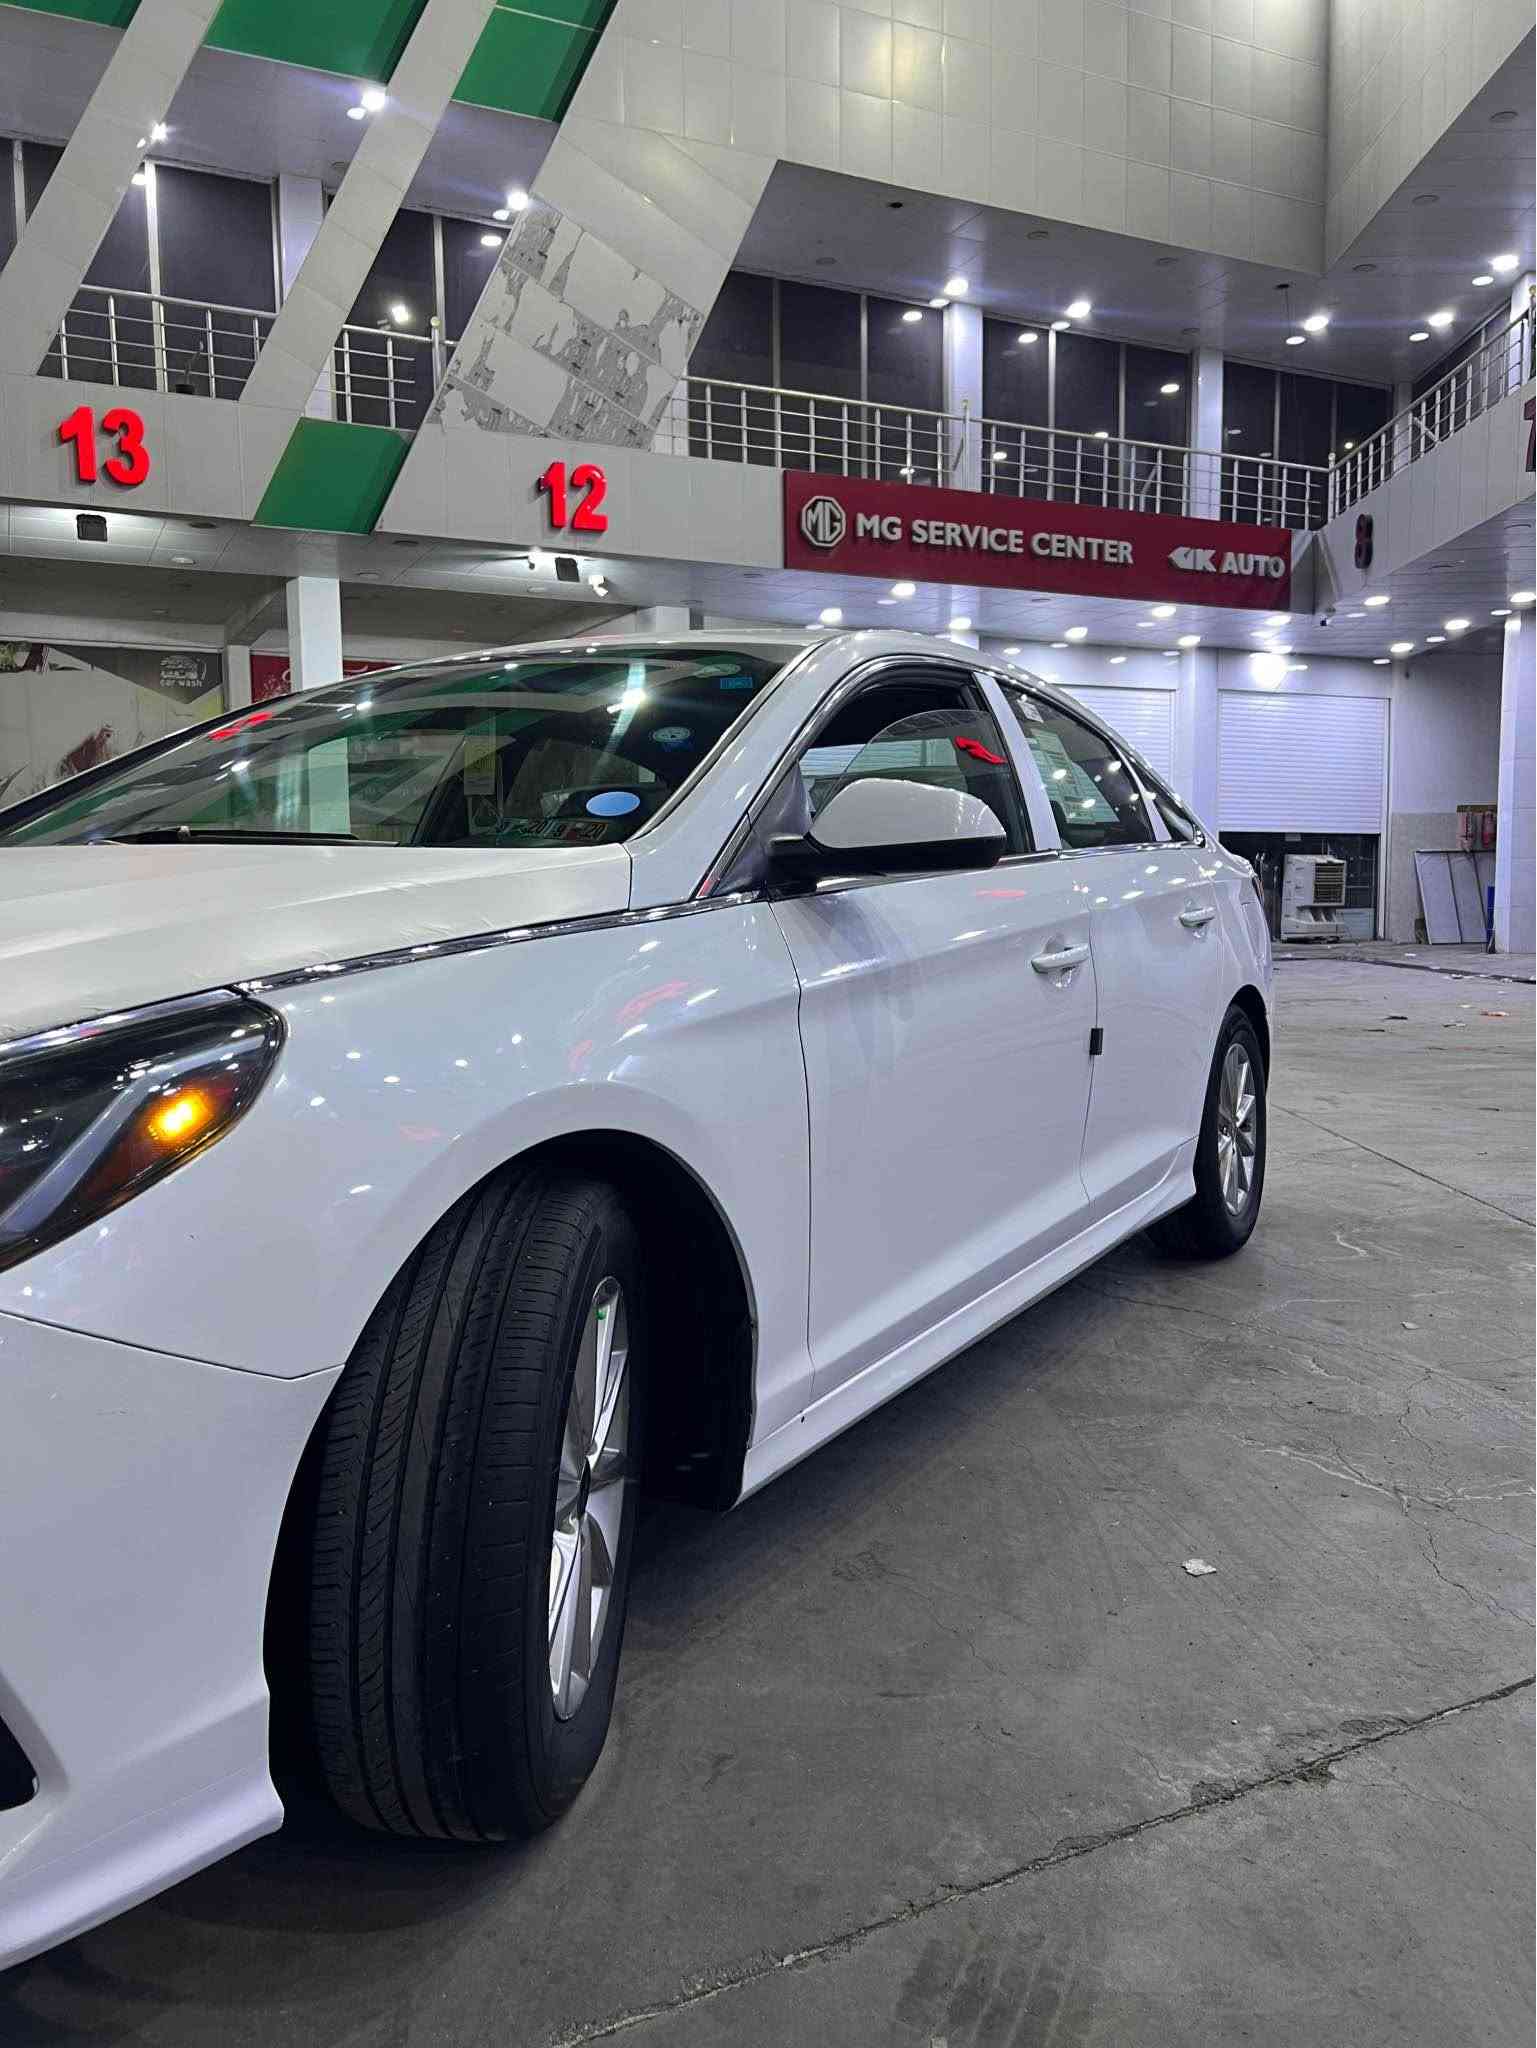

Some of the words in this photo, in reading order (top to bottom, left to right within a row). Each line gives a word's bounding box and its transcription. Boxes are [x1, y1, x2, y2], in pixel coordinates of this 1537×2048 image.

[57, 406, 151, 488] 13
[536, 460, 609, 533] 12
[856, 512, 902, 541] MG
[911, 519, 1024, 554] SERVICE
[1031, 532, 1135, 565] CENTER
[1220, 551, 1286, 579] AUTO
[1355, 513, 1374, 569] 8
